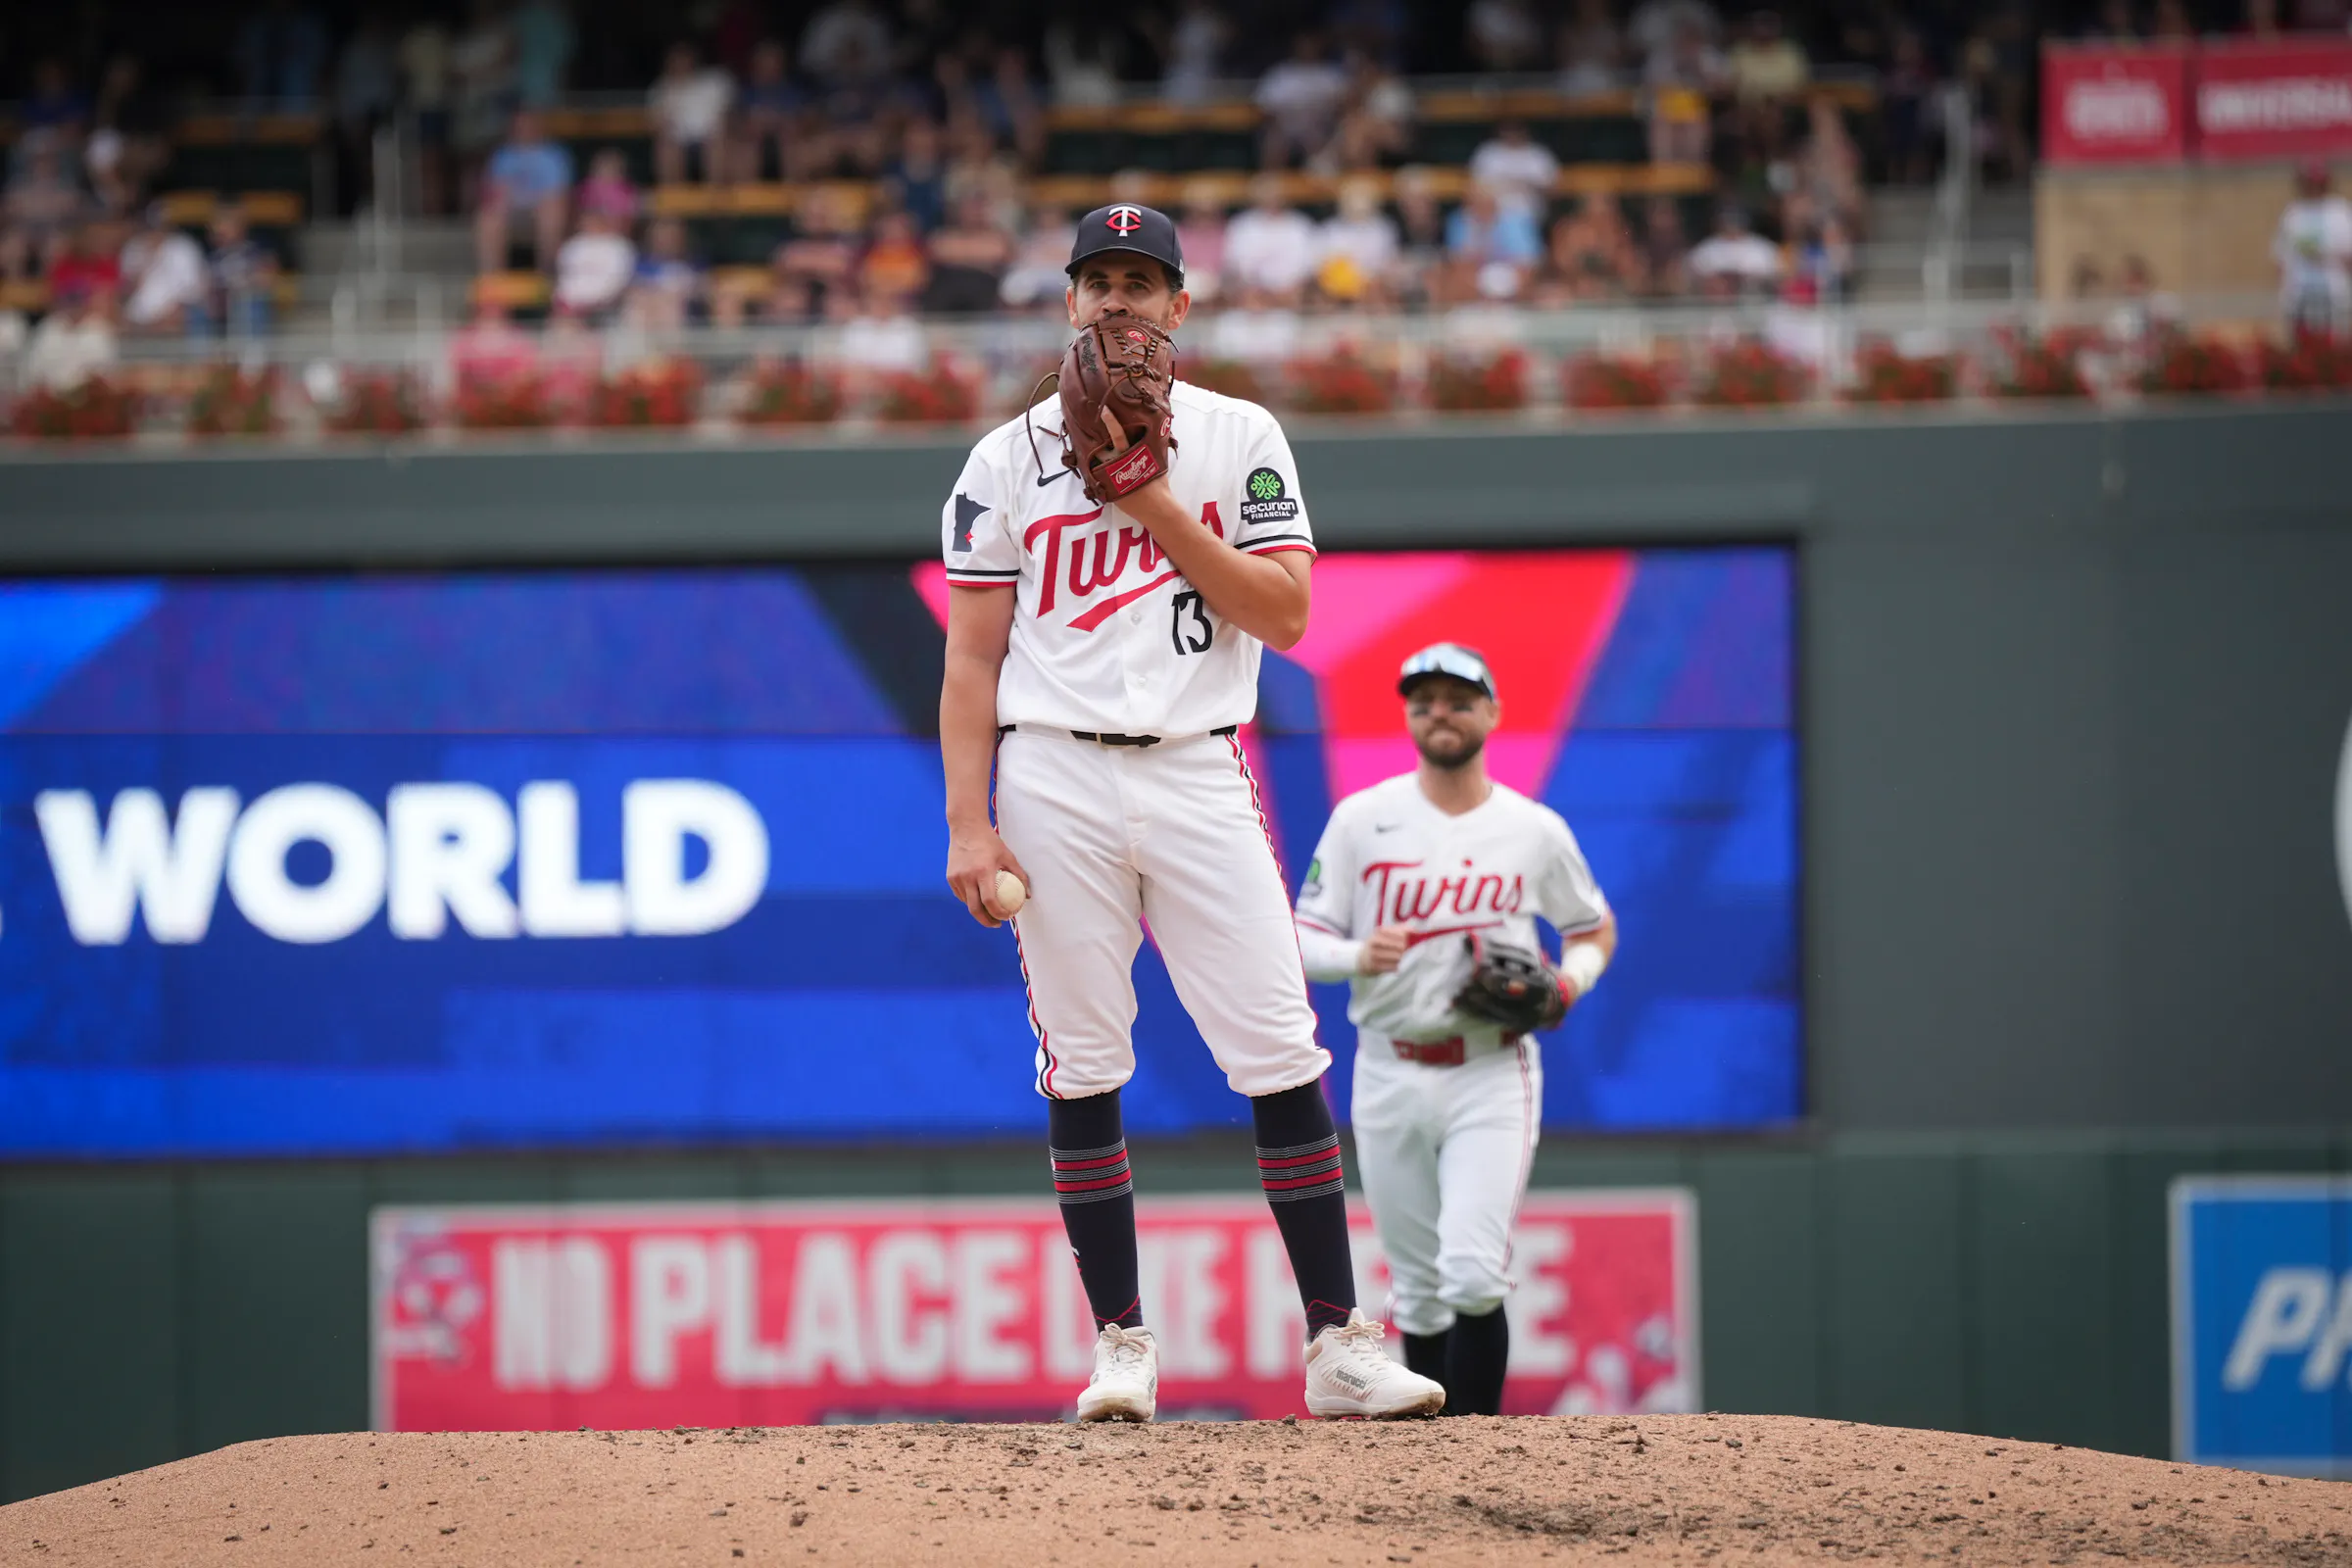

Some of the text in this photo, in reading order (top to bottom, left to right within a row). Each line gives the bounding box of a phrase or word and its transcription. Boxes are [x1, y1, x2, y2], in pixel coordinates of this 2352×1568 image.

[1115, 455, 1149, 484] Rawlings
[1242, 501, 1296, 515] securian
[1250, 511, 1292, 520] FINANCIAL
[1171, 590, 1213, 656] 13
[34, 779, 771, 946] WORLD
[1361, 858, 1524, 928] Twins
[493, 1235, 617, 1392] NO
[627, 1228, 1032, 1388] PLACE
[1336, 1369, 1367, 1391] marucci
